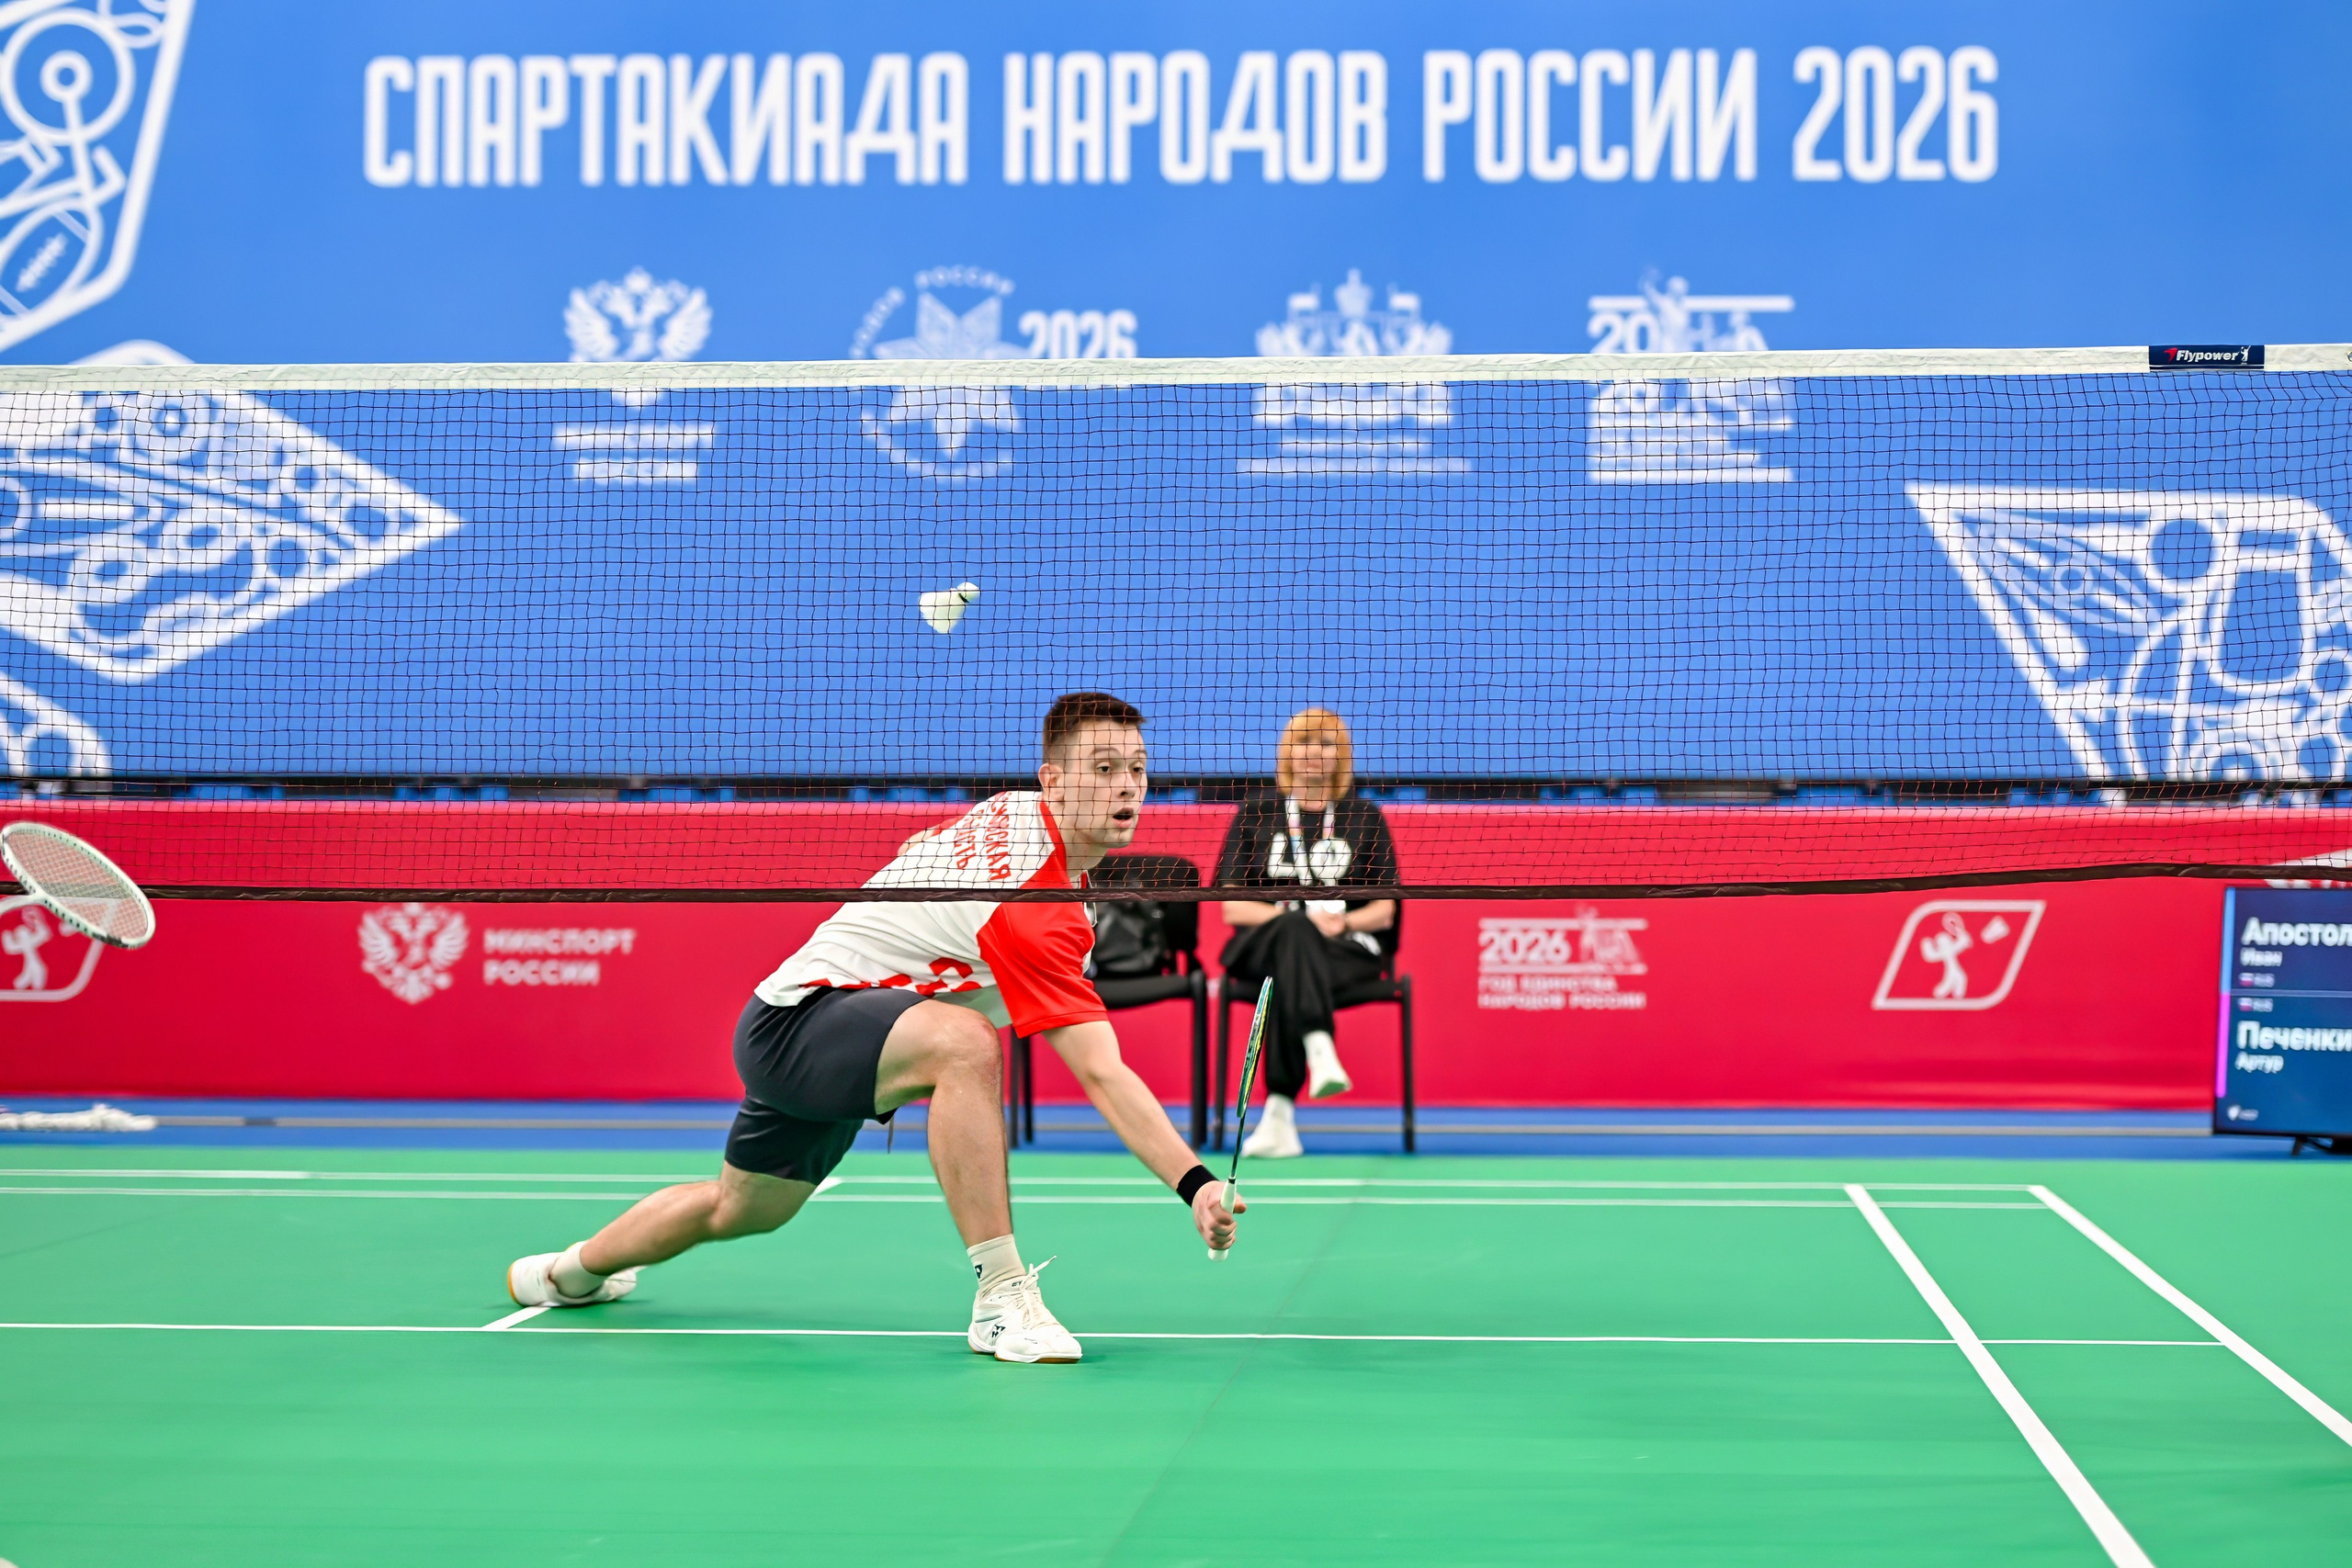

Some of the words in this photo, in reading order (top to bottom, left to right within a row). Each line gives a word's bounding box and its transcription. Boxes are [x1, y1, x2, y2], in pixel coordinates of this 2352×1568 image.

[365, 52, 967, 186] СПАРТАКИАДА
[1004, 51, 1386, 184] НАРОДОВ
[1424, 49, 1757, 182] РОССИИ
[1793, 46, 1997, 182] 2026
[2176, 349, 2239, 363] Flypower
[483, 928, 636, 953] МИНСПОРТ
[1478, 930, 1572, 964] 2026
[2241, 917, 2352, 947] Апостол
[483, 959, 601, 986] РОССИИ
[2236, 1020, 2352, 1052] Печенки
